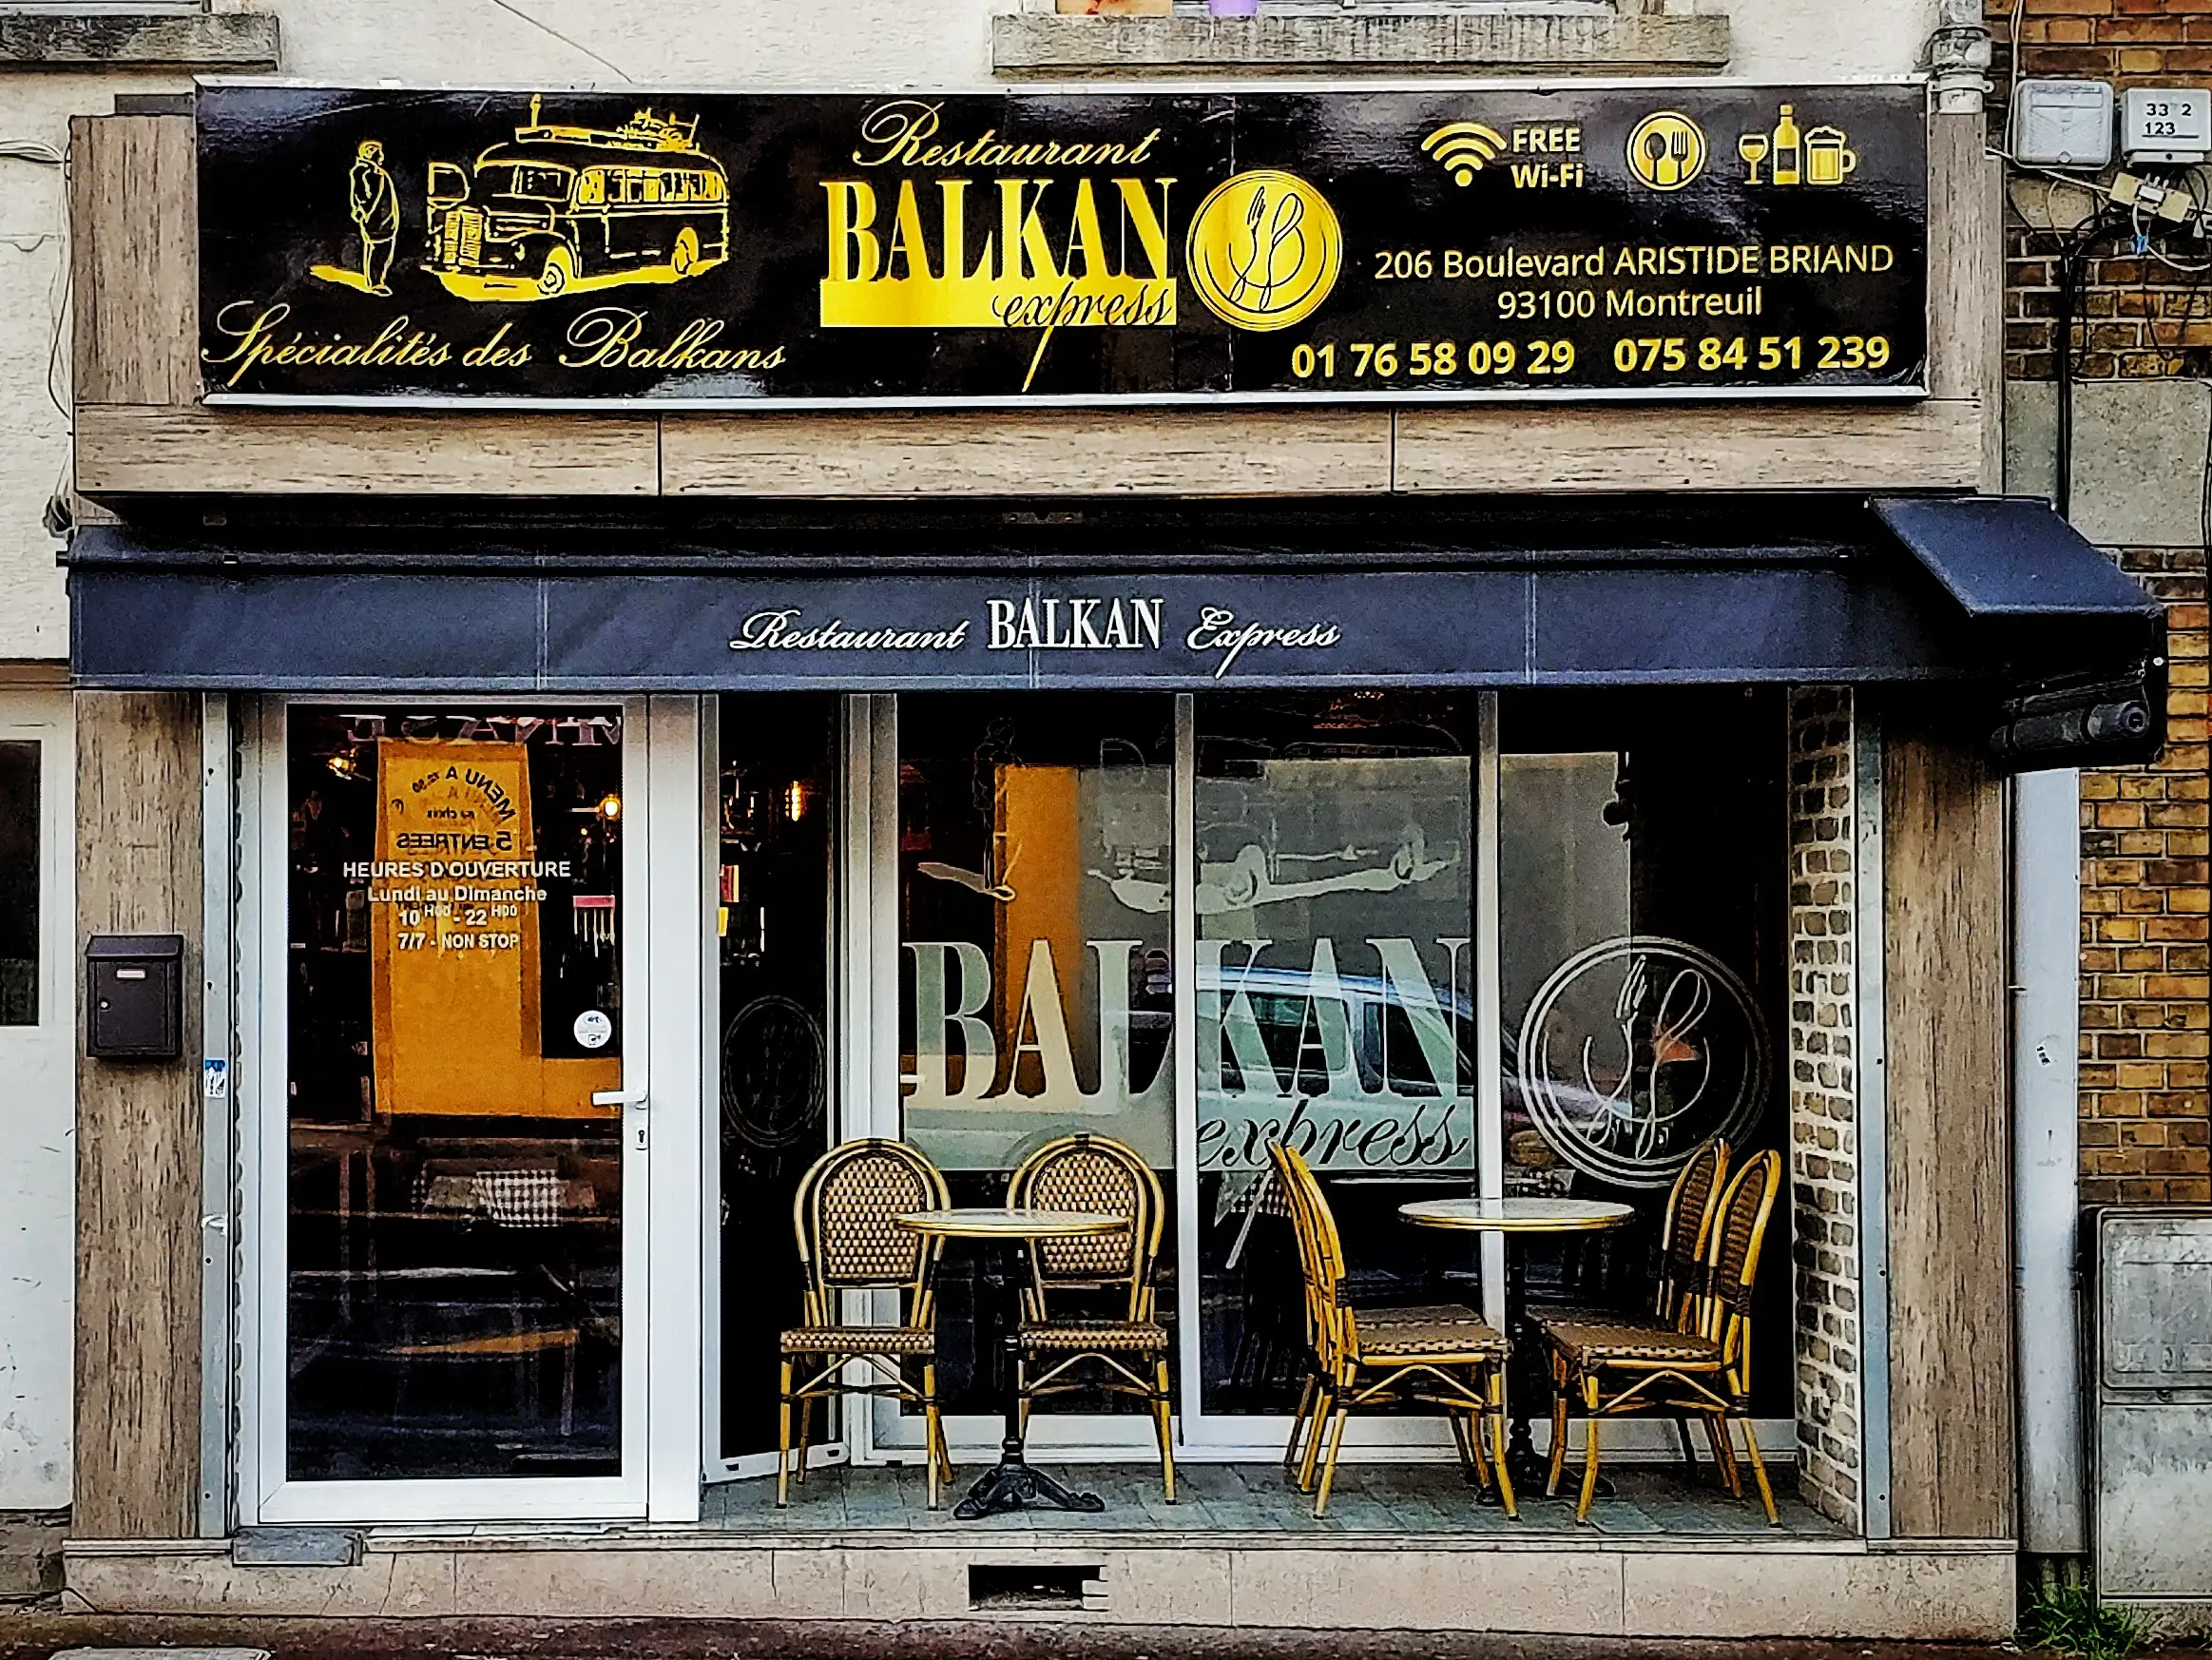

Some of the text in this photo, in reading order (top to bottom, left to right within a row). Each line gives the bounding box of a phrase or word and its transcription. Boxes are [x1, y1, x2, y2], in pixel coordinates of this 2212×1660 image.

[2146, 103, 2169, 117] 33
[852, 100, 1161, 166] Restaurant
[1511, 126, 1580, 153] FREE
[2145, 122, 2176, 135] 123
[1510, 163, 1585, 189] Wi-Fi
[819, 178, 1178, 282] BALKAN
[1375, 244, 1894, 280] 206 Boulevard ARISTIDE BRIAND
[1497, 287, 1762, 319] 93100 Montreuil
[201, 300, 786, 386] Spécialités des Balkans
[1291, 339, 1575, 377] 01 76 58 09 29
[1613, 336, 1890, 373] 075 84 51 239
[729, 598, 1340, 679] Restaurant BALKAN Express
[343, 860, 571, 878] HEURES D'OUVERTURE
[368, 885, 548, 901] Lundi au Dimanche
[397, 933, 426, 950] 7/7
[442, 934, 474, 949] NON
[478, 934, 519, 949] STOP
[902, 938, 1471, 1099] BALKAN
